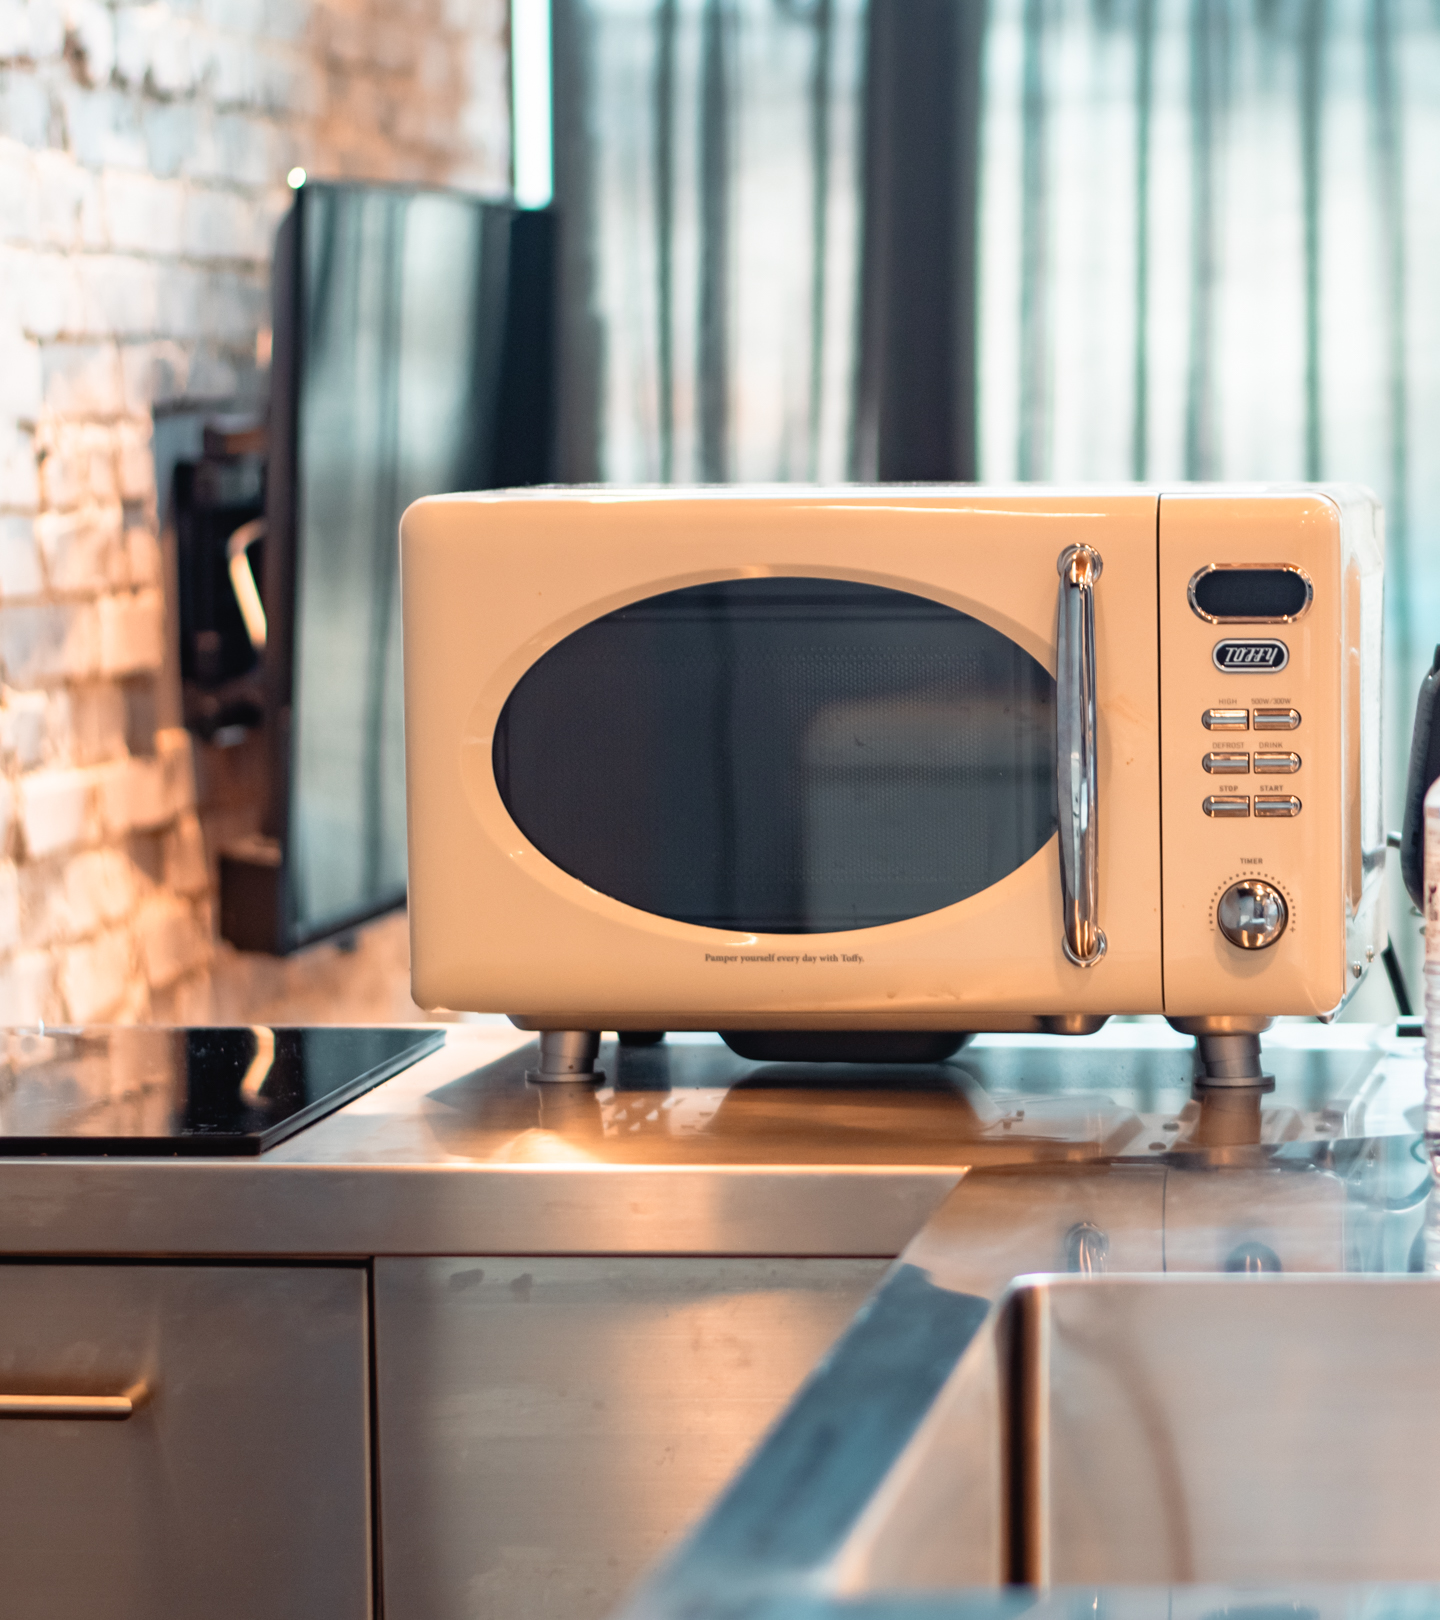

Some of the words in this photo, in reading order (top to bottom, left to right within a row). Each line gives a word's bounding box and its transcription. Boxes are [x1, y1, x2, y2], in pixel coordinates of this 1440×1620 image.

[1224, 647, 1278, 665] TOFFY
[1240, 857, 1263, 865] TIMER
[705, 953, 738, 964] Pamper
[740, 953, 775, 964] yourself
[777, 955, 799, 964] every
[802, 953, 817, 964] day
[819, 953, 838, 962] with
[840, 953, 864, 964] Toffy.
